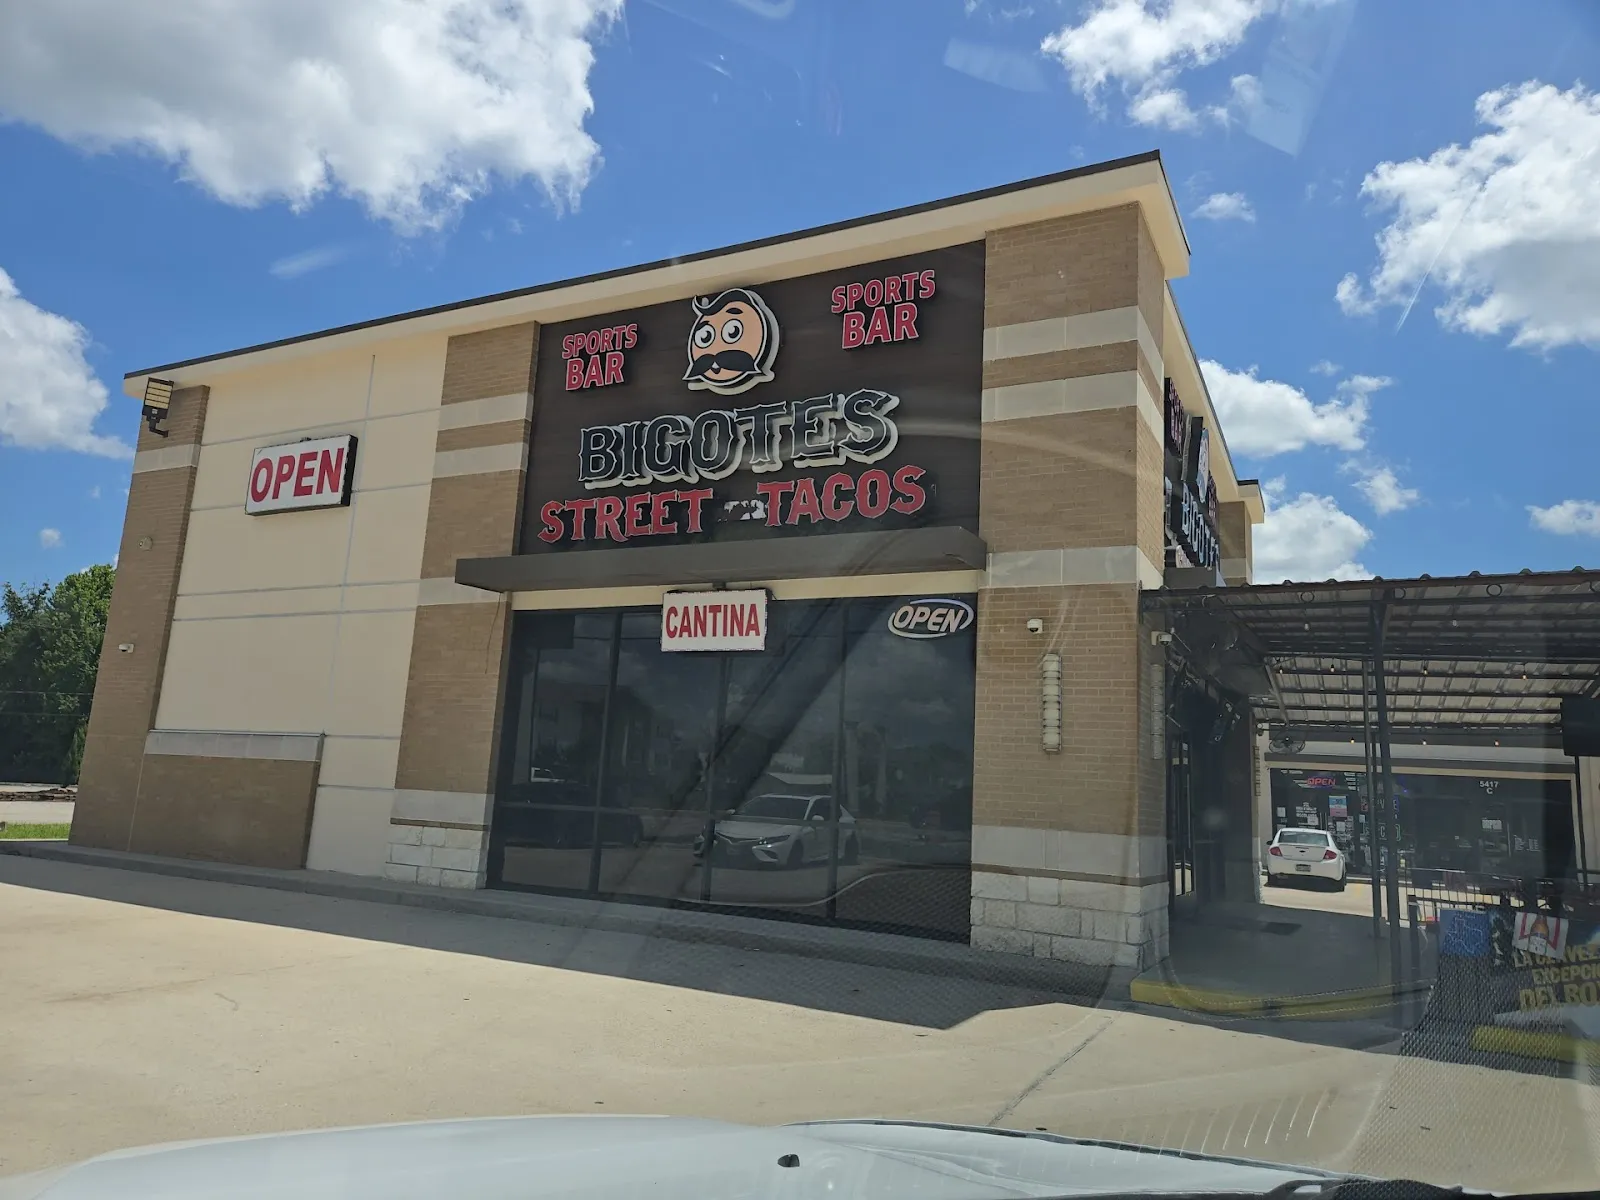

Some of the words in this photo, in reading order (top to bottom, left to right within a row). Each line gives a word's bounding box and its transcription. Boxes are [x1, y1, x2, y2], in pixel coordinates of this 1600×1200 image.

[831, 269, 936, 314] SPORTS
[561, 323, 638, 360] SPORTS
[842, 303, 919, 350] BAR
[565, 352, 624, 391] BAR
[578, 388, 899, 488] BIGOTES
[250, 448, 344, 502] OPEN
[540, 488, 713, 543] STREET
[757, 464, 926, 527] TACOS
[665, 604, 760, 639] CANTINA
[894, 609, 962, 633] OPEN
[1306, 777, 1336, 786] OPEN
[1479, 780, 1499, 788] 5417
[1486, 787, 1493, 795] C
[1563, 981, 1600, 1007] BO
